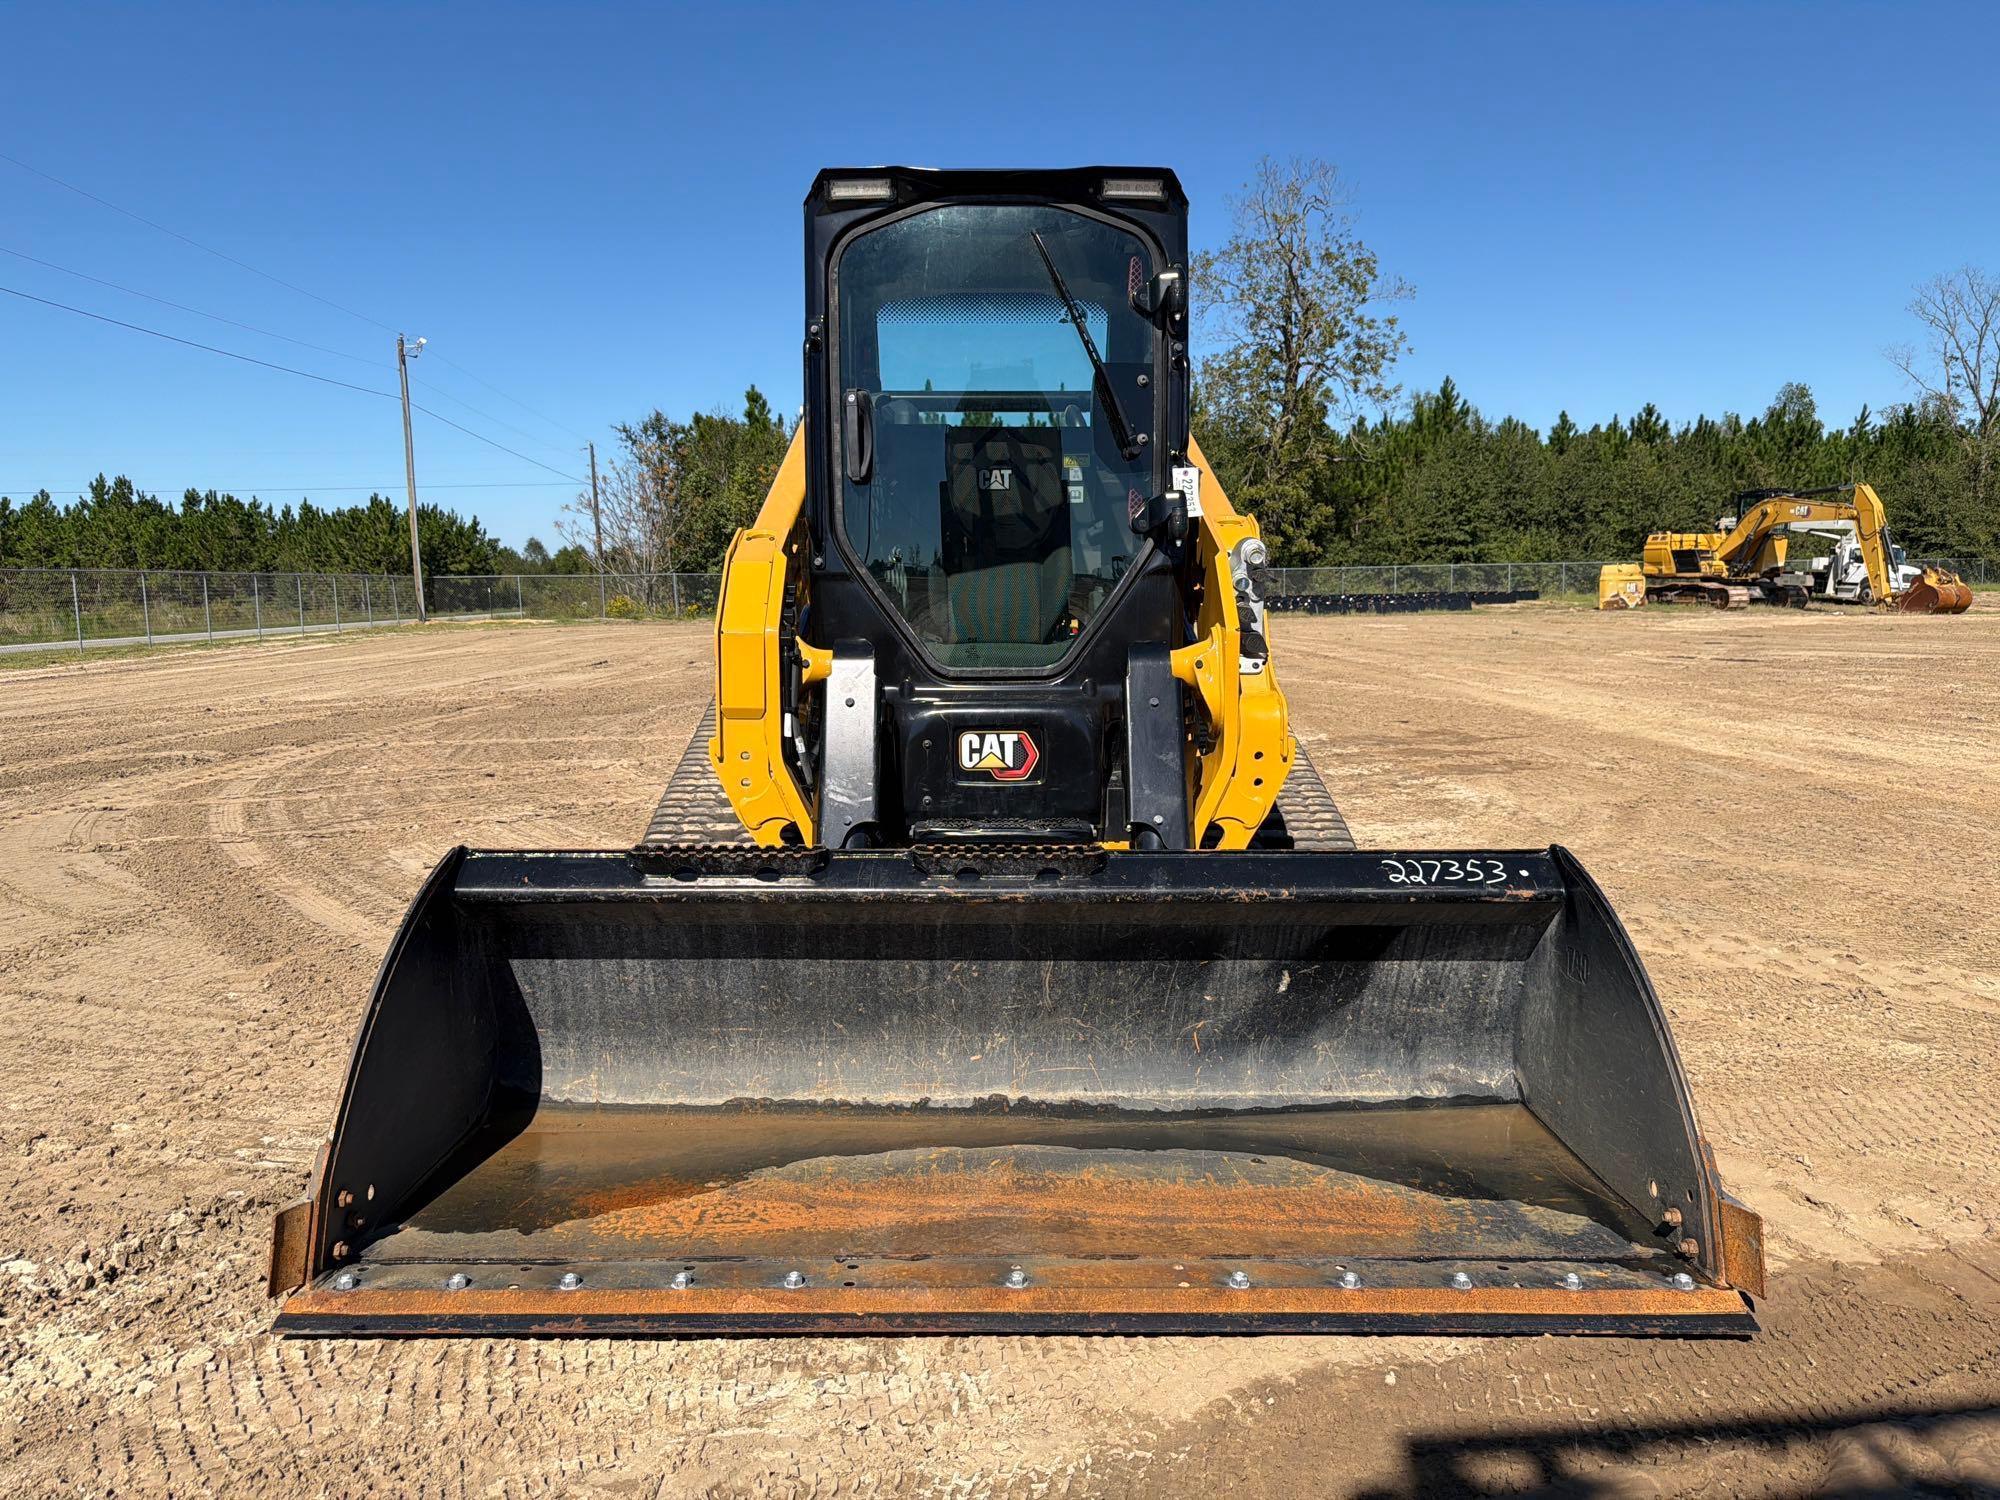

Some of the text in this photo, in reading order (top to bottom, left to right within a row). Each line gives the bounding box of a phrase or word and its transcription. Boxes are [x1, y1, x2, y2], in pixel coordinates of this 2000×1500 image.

[979, 469, 1012, 489] CAT
[961, 733, 1018, 768] CAT
[1381, 859, 1507, 885] 227353
